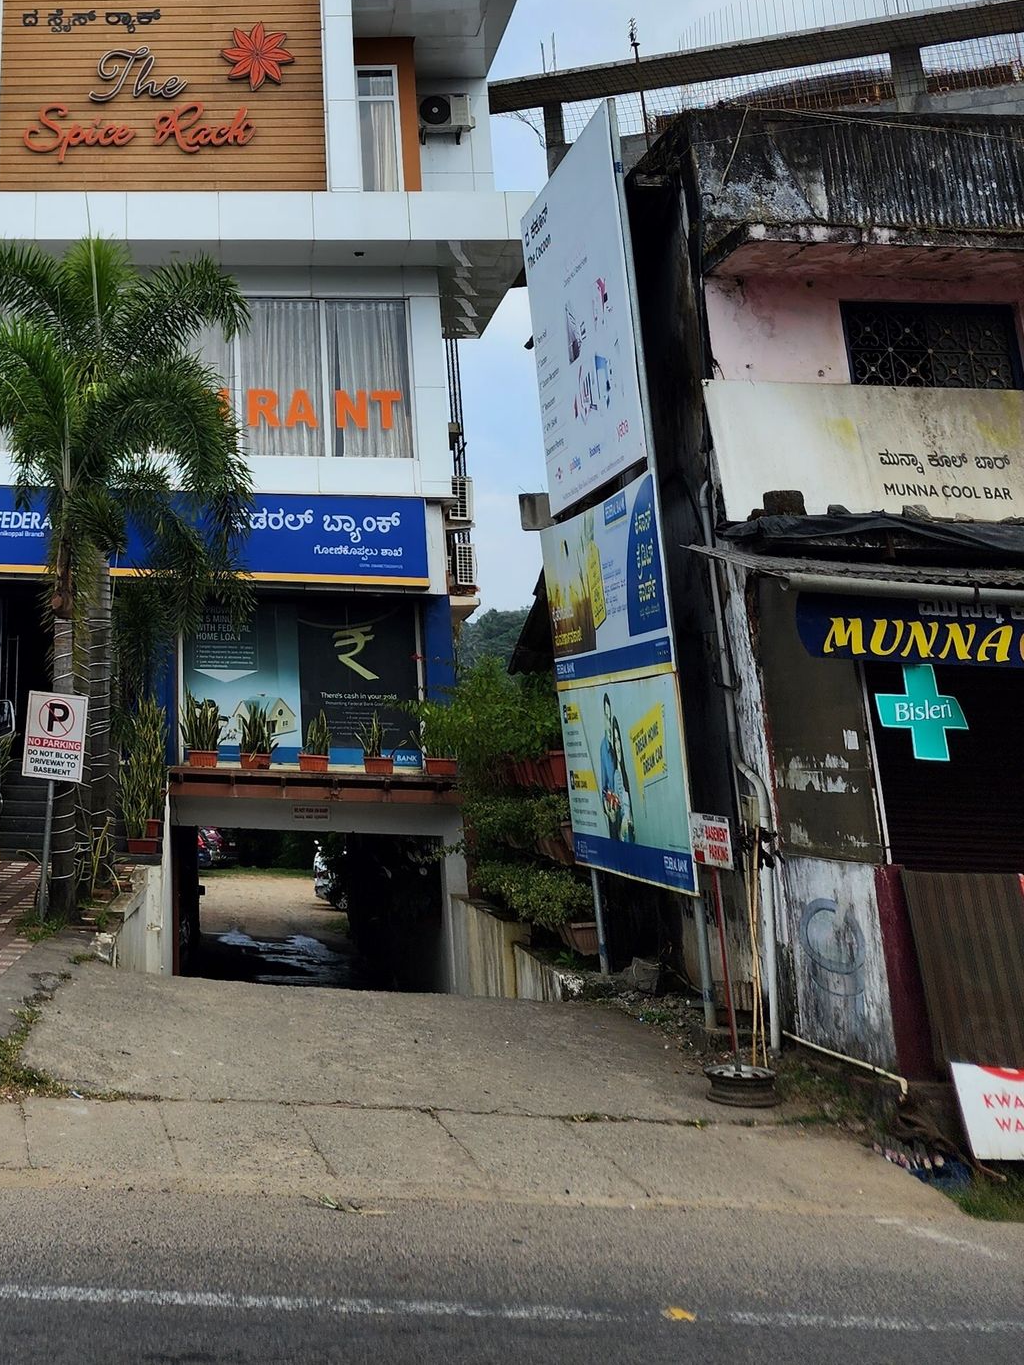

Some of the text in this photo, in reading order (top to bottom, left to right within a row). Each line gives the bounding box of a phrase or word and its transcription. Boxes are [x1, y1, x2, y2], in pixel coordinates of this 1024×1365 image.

[89, 46, 188, 102] The
[23, 102, 257, 164] Spice Rack
[216, 388, 402, 430] RANT
[884, 483, 1013, 500] MUNNA COOL BAR
[196, 633, 219, 641] HOME
[823, 617, 1013, 663] MUNNA
[320, 691, 343, 699] There's
[895, 700, 953, 722] Bisleri
[28, 737, 81, 750] NO PARKING
[30, 757, 65, 767] DRIVEWAY
[55, 752, 79, 760] BLOCK
[396, 754, 418, 762] BANK
[33, 766, 71, 775] BASEMENT
